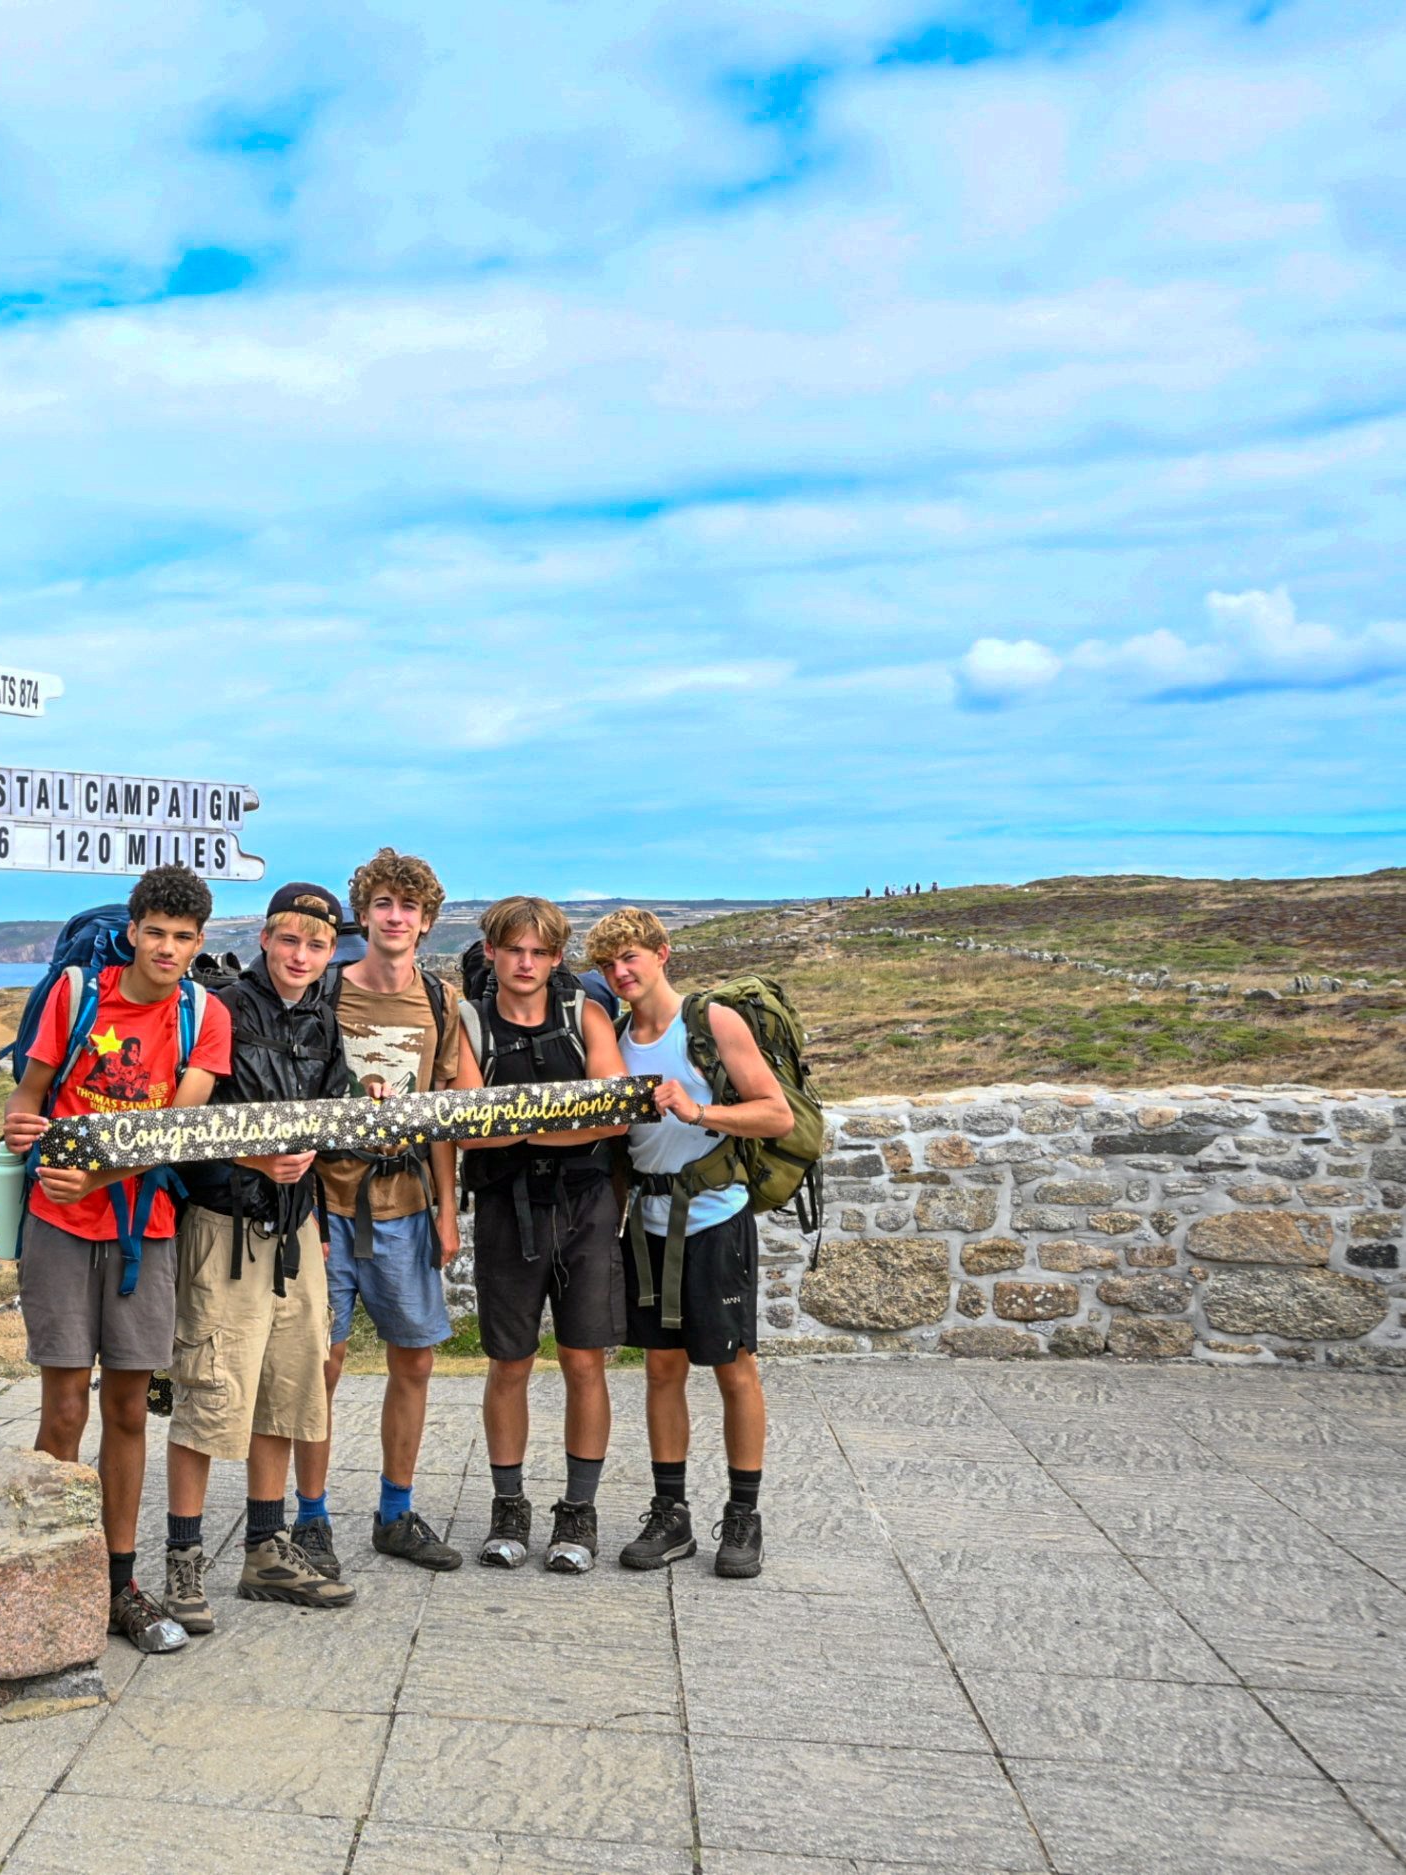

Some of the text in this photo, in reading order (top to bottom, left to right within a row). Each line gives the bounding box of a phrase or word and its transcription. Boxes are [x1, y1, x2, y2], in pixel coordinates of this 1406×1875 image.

[19, 678, 39, 710] 874
[85, 780, 241, 822] CAMPAIGN
[56, 829, 112, 865] 120
[128, 833, 227, 870] MILES
[76, 1085, 118, 1109] THOMAS
[114, 1089, 616, 1161] Congratulations Congratulations
